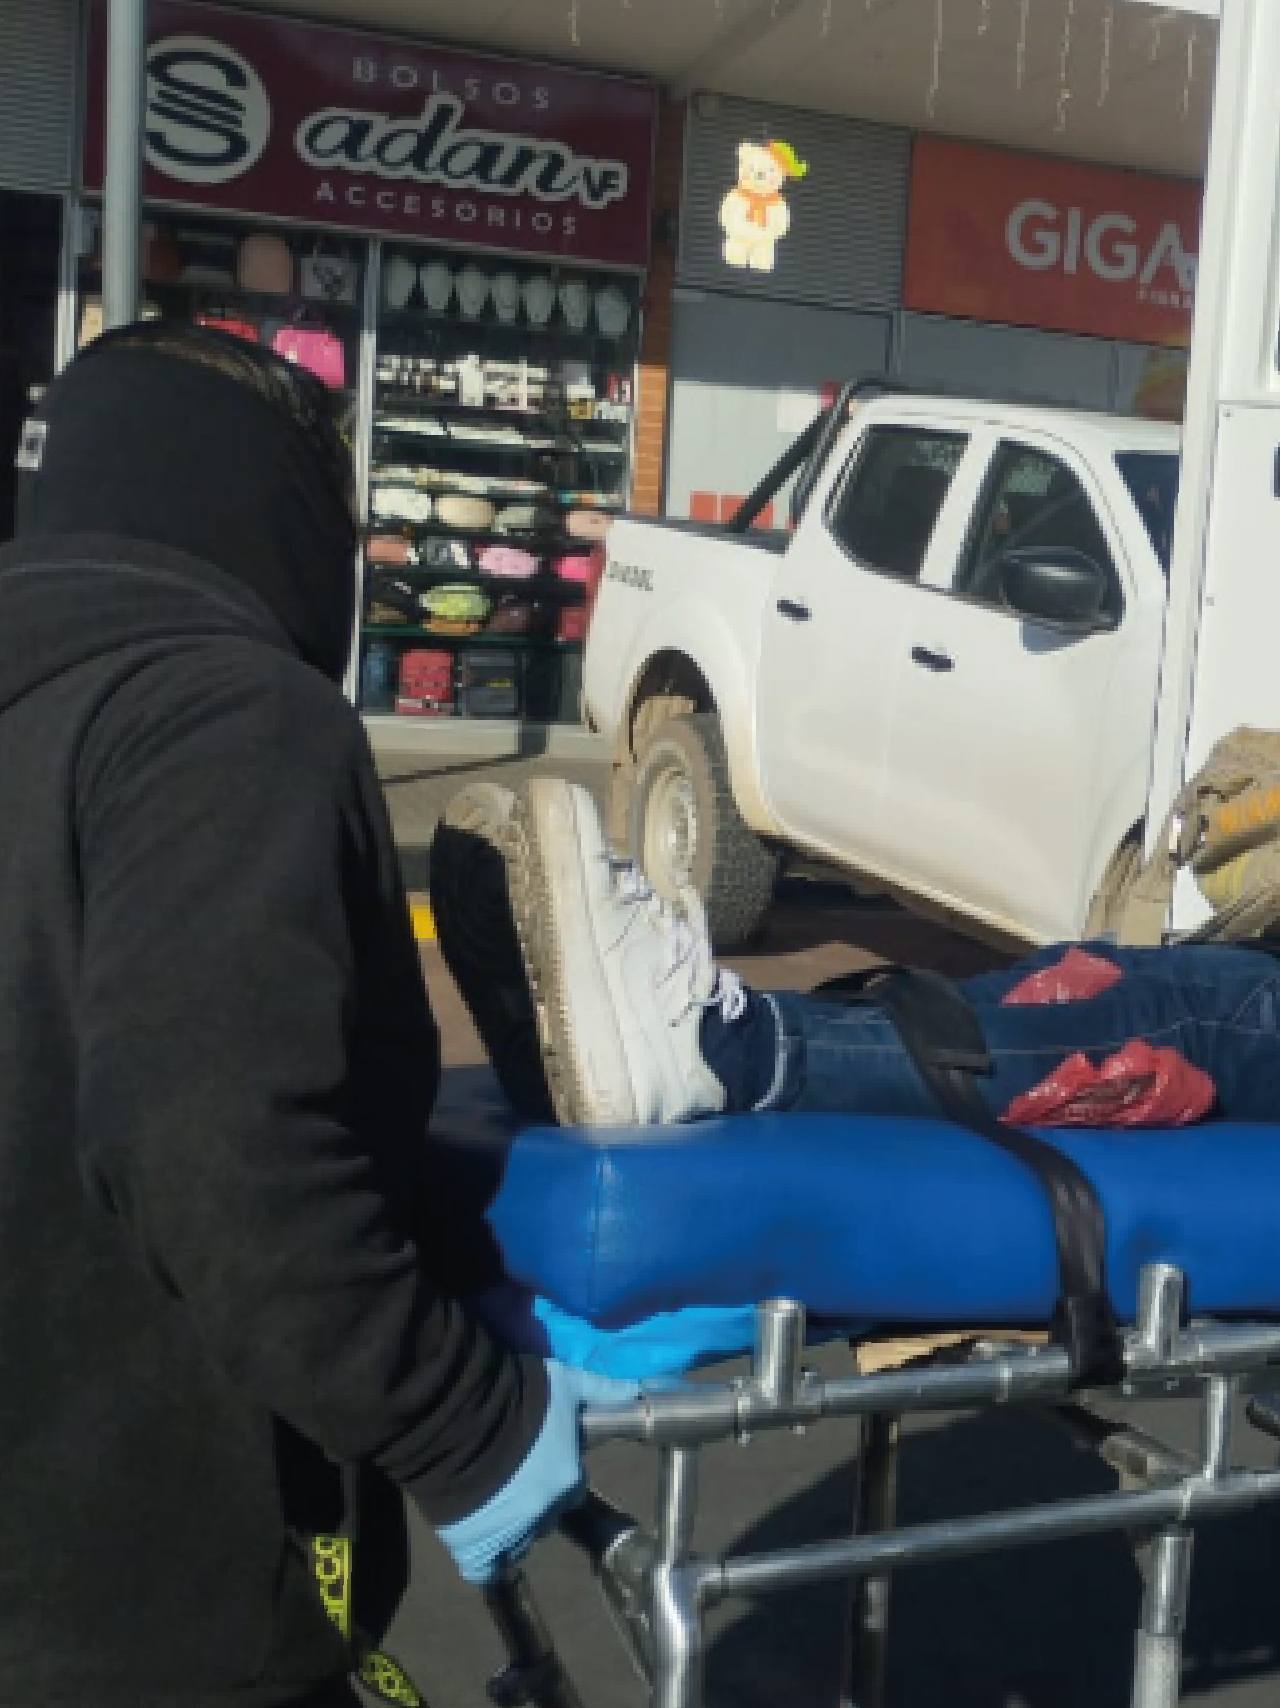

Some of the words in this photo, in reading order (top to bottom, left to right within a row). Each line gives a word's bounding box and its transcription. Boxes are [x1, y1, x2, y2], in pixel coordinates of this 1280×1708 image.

[352, 56, 550, 110] BOLSOS
[316, 181, 577, 235] ACCESORIOS
[1005, 198, 1197, 291] GIGA
